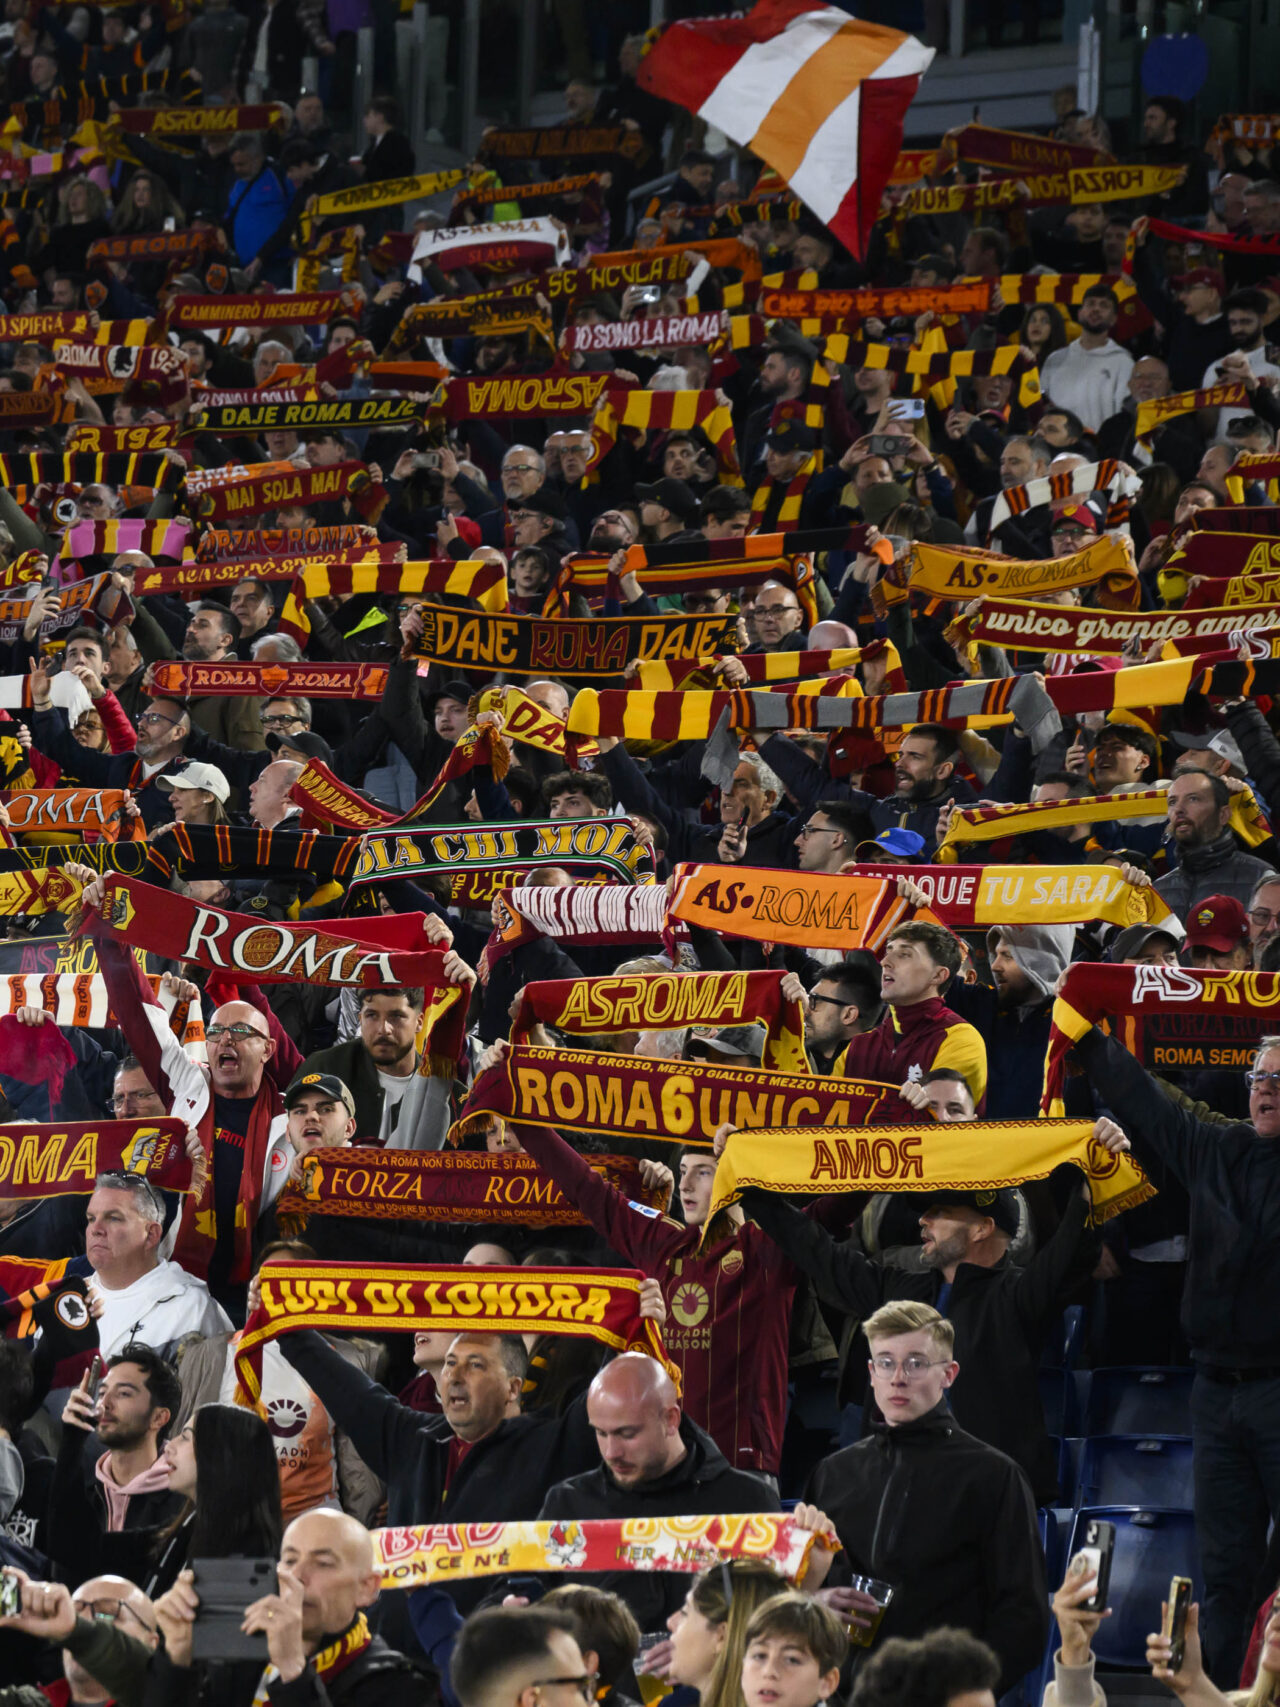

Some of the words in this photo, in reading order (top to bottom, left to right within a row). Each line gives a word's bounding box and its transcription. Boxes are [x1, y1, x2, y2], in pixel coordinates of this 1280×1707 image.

[152, 106, 239, 133] ASROMA
[665, 314, 720, 342] ROMA
[468, 374, 609, 413] ASROMA
[221, 405, 278, 426] DAJE
[285, 401, 352, 423] ROMA
[358, 396, 417, 421] DAJE
[224, 486, 255, 511] MAI
[263, 476, 303, 504] SOLA
[311, 469, 342, 493] MAI
[435, 612, 519, 665] DAJE
[529, 622, 630, 669] ROMA
[638, 617, 728, 660] DAJE
[986, 611, 1073, 637] unico
[1075, 616, 1192, 647] grande
[1195, 609, 1280, 638] amor
[195, 668, 257, 687] ROMA
[287, 670, 352, 688] ROMA
[431, 830, 519, 862] CHI
[986, 876, 1024, 906] TU
[181, 904, 402, 985] ROMA
[555, 972, 748, 1028] ASROMA
[558, 1051, 594, 1066] CORE
[657, 1062, 703, 1077] MEZZO
[706, 1067, 754, 1083] GIALLO
[769, 1075, 816, 1091] MEZZO
[1154, 1048, 1205, 1065] ROMA
[150, 1133, 173, 1170] ROMA
[375, 1155, 388, 1167] LA
[390, 1156, 419, 1168] ROMA
[421, 1157, 444, 1169] NON
[445, 1158, 455, 1169] SI
[502, 1159, 512, 1170] SI
[514, 1159, 537, 1170] AMA
[330, 1167, 424, 1200] FORZA
[483, 1175, 564, 1205] ROM
[261, 1280, 352, 1318] LUPI
[363, 1282, 417, 1315] DI
[425, 1282, 611, 1324] LONDRA
[663, 1327, 711, 1338] RIYADH
[663, 1339, 711, 1350] SEASON
[380, 1521, 506, 1563] BAD
[436, 1555, 462, 1569] CE
[616, 1546, 654, 1562] PER
